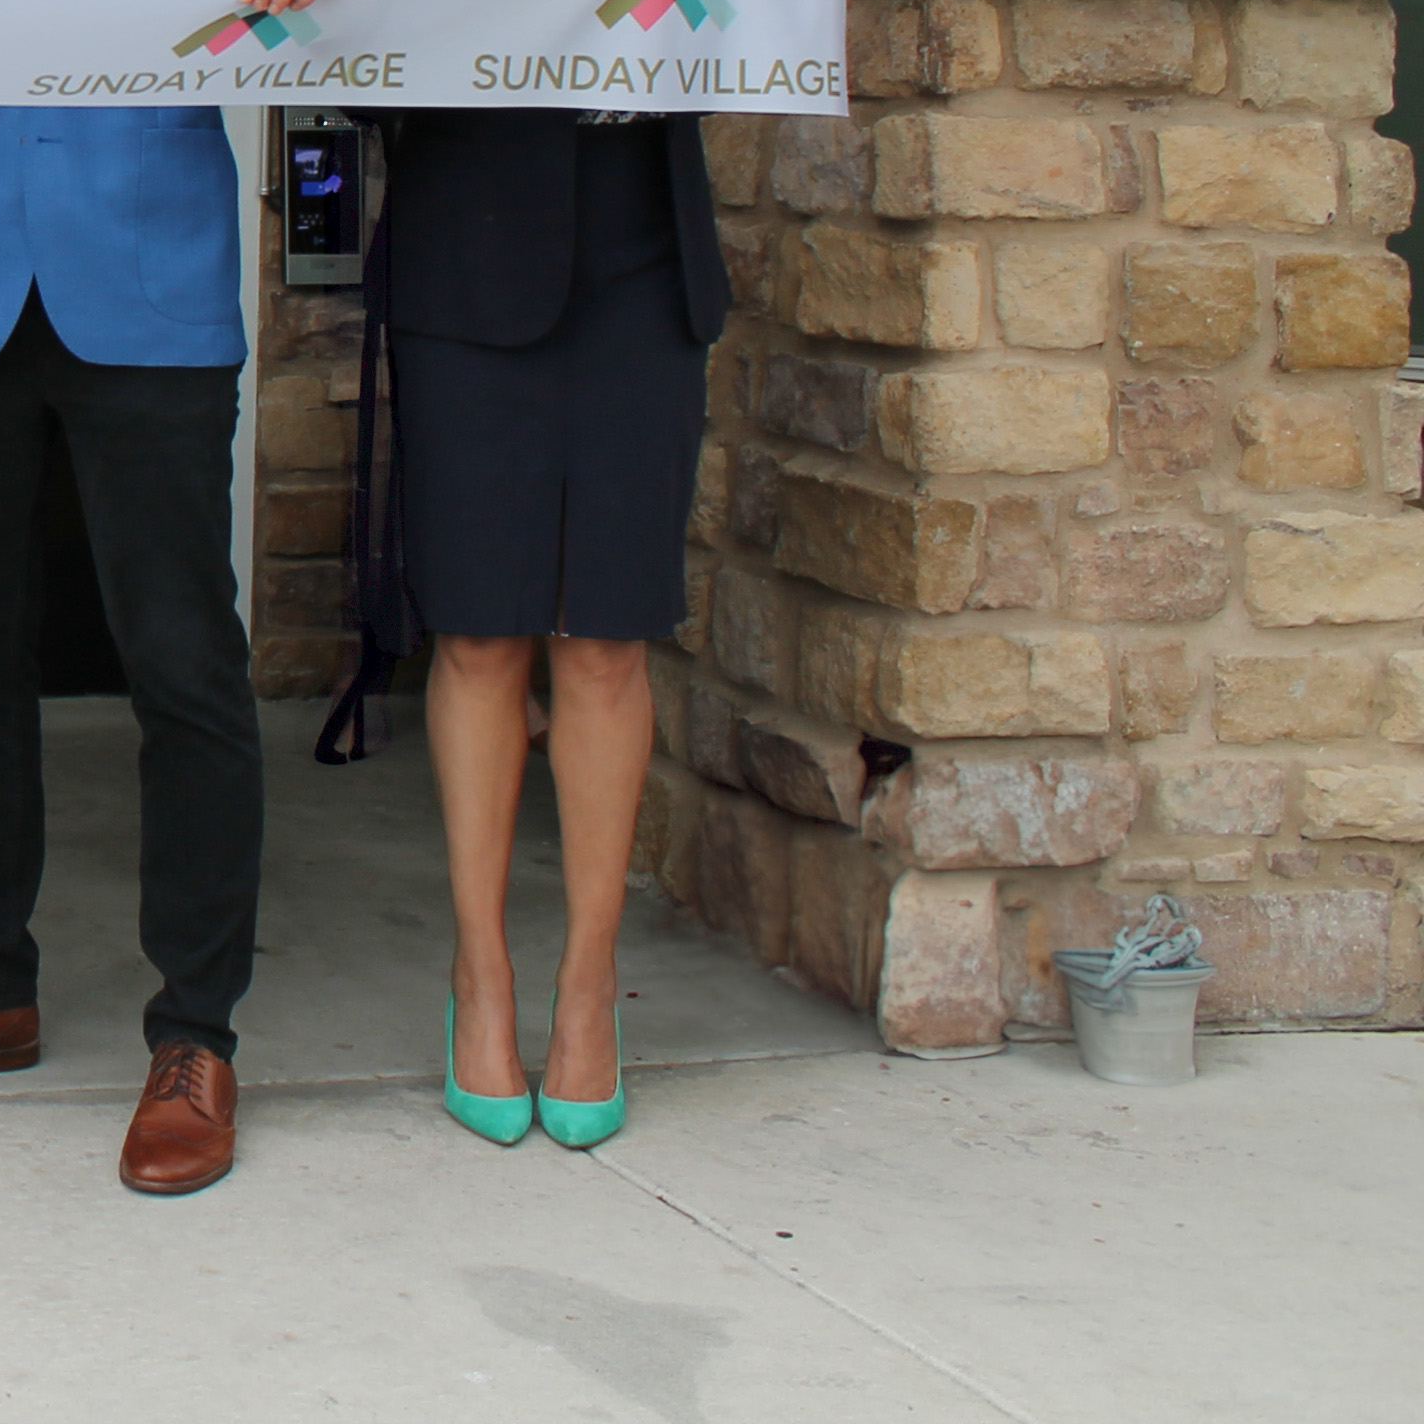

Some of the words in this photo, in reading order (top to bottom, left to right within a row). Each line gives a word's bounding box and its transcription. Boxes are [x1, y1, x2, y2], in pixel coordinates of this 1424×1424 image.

[26, 67, 224, 97] SUNDAY
[234, 52, 407, 89] VILLAGE
[472, 53, 666, 95] SUNDAY
[676, 58, 841, 98] VILLAGE
